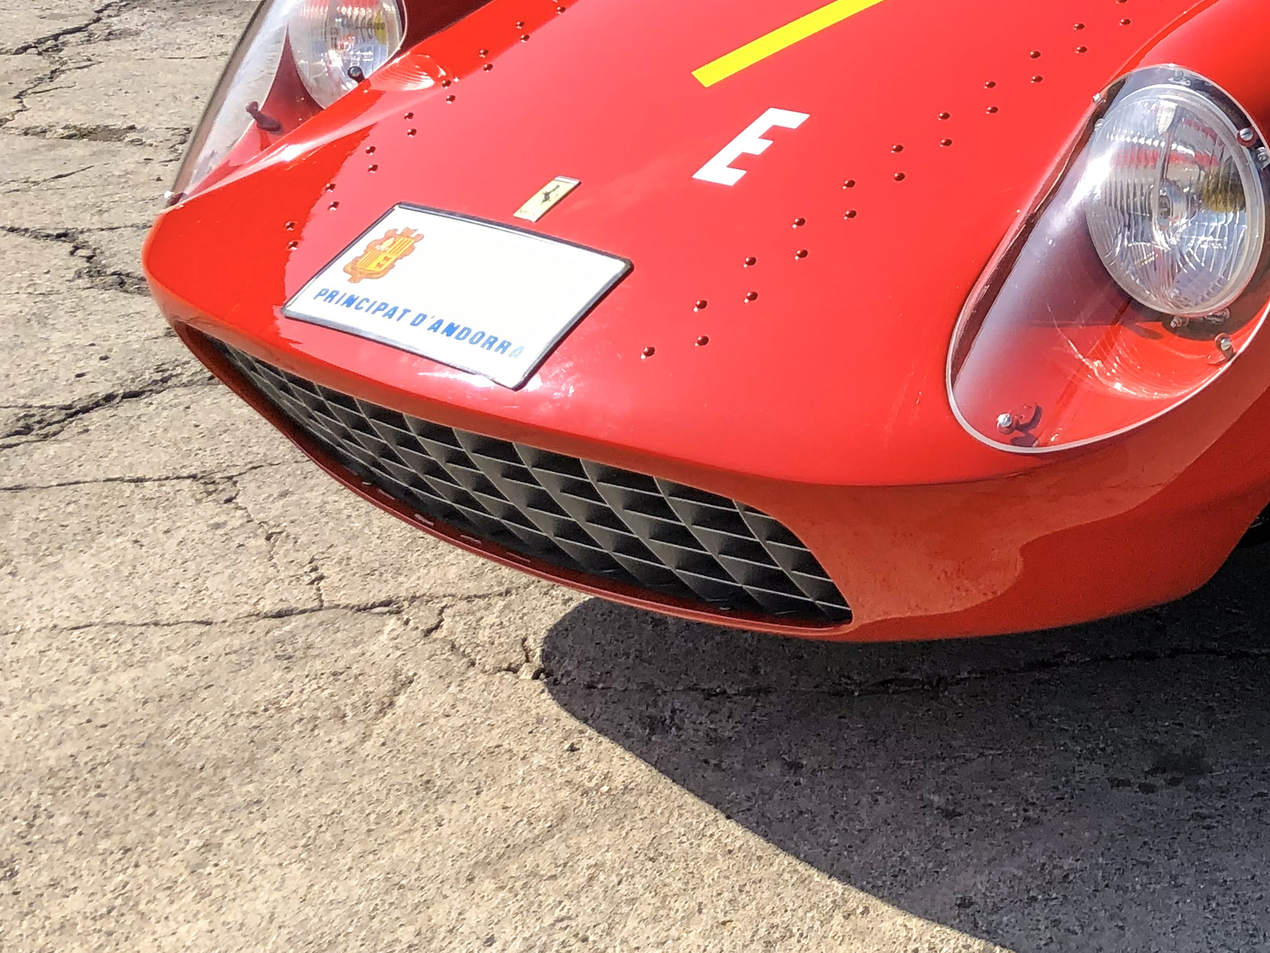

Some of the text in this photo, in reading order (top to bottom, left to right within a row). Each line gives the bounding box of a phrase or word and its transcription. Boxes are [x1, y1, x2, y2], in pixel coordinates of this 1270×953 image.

[691, 107, 810, 186] E
[313, 288, 525, 359] PRINCIPAT D'ANDORRA
